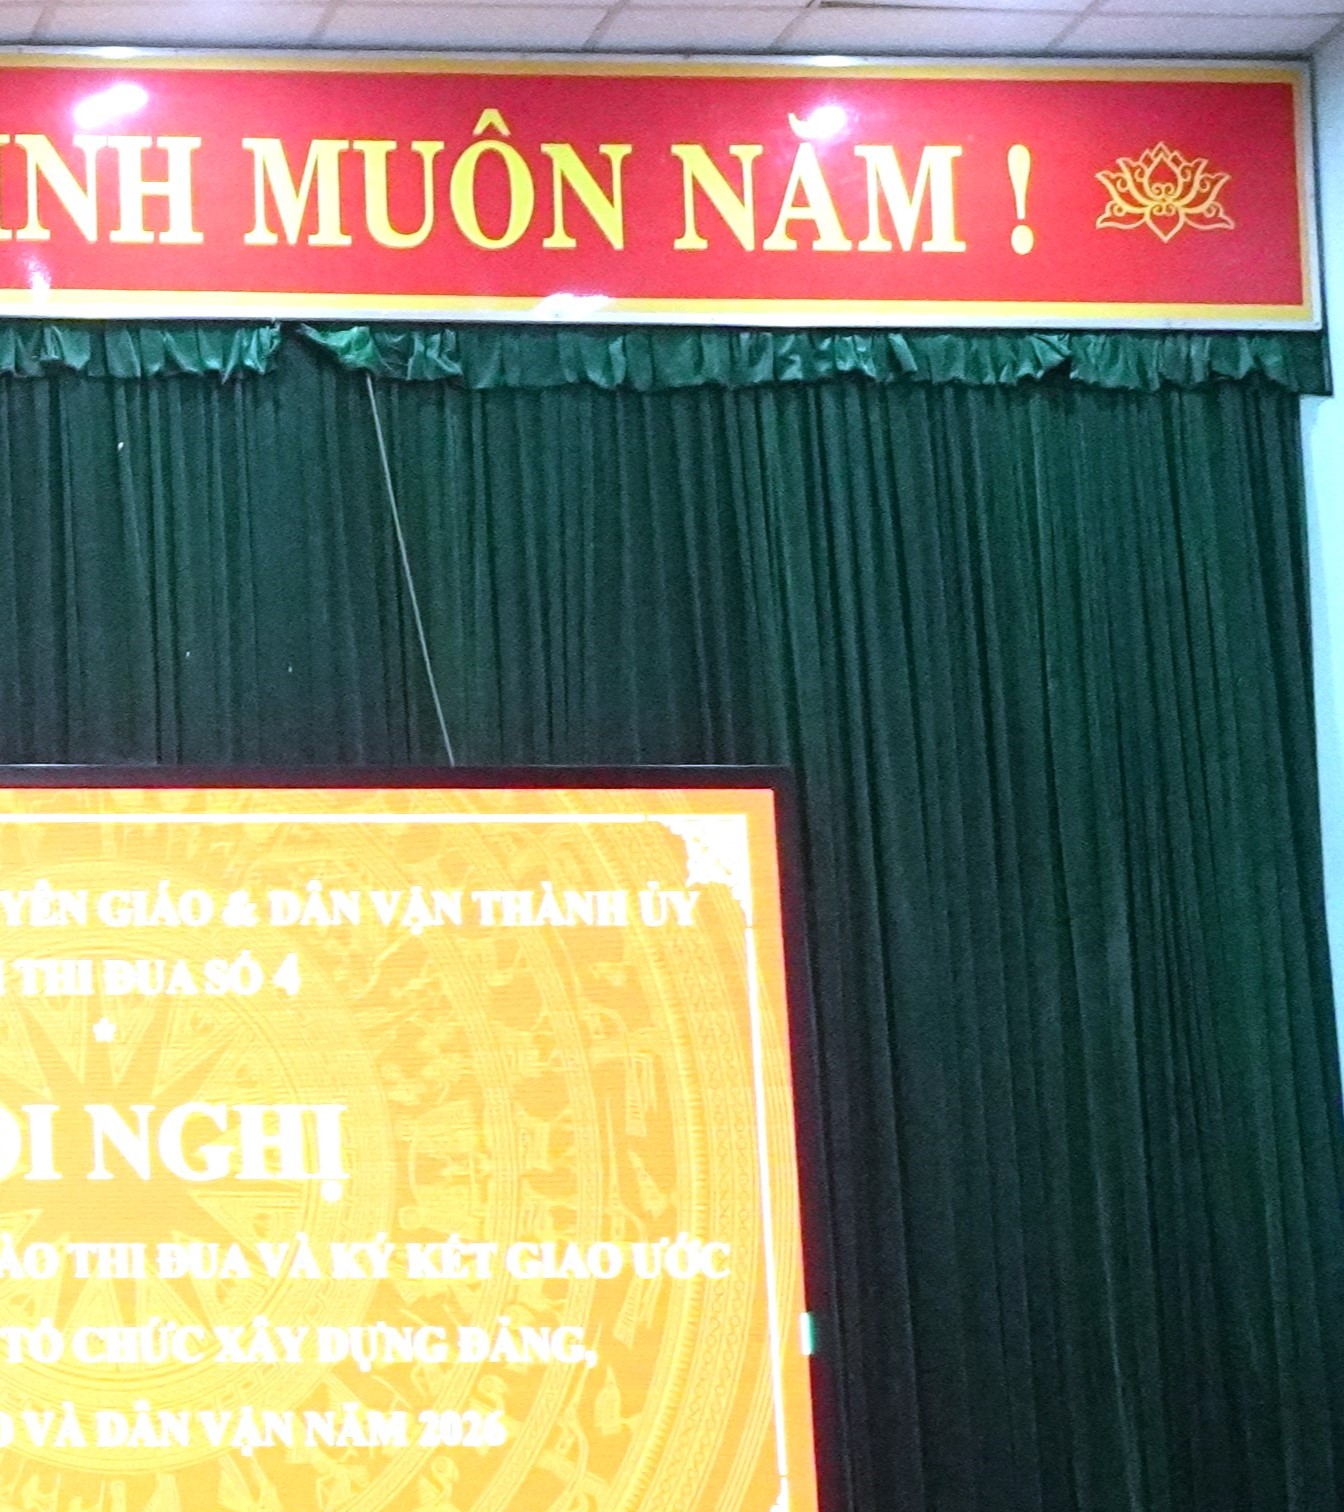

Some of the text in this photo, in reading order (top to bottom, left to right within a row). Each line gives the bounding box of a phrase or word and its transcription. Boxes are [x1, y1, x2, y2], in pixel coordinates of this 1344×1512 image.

[241, 108, 632, 251] MUÔN
[671, 105, 966, 252] NĂM
[1006, 144, 1034, 255] !
[97, 880, 213, 927] GIÁO
[222, 889, 257, 927] &
[268, 880, 359, 927] DÂN
[370, 885, 461, 935] VẬN
[472, 881, 627, 927] THÀNH
[639, 880, 702, 927] ỦY
[12, 958, 93, 996] THI
[103, 959, 198, 996] ĐUA
[204, 950, 263, 996] SỐ
[273, 953, 301, 995] 4
[85, 1102, 349, 1203] NGHỊ
[66, 1242, 146, 1280] THI
[157, 1241, 251, 1280] ĐUA
[257, 1233, 321, 1279] VÀ
[330, 1233, 394, 1280] KÝ
[407, 1234, 497, 1279] KẾT
[506, 1241, 622, 1279] GIAO
[632, 1233, 730, 1280] ƯỚC
[0, 1317, 64, 1364] TỔ
[72, 1317, 204, 1364] CHỨC
[214, 1317, 308, 1364] XÂY
[317, 1321, 447, 1371] DỰNG
[458, 1317, 596, 1368] ĐẢNG,
[22, 1401, 86, 1448] VÀ
[96, 1400, 189, 1448] DÂN
[198, 1405, 293, 1456] VẬN
[305, 1401, 407, 1448] NĂM
[419, 1409, 506, 1447] 2026
